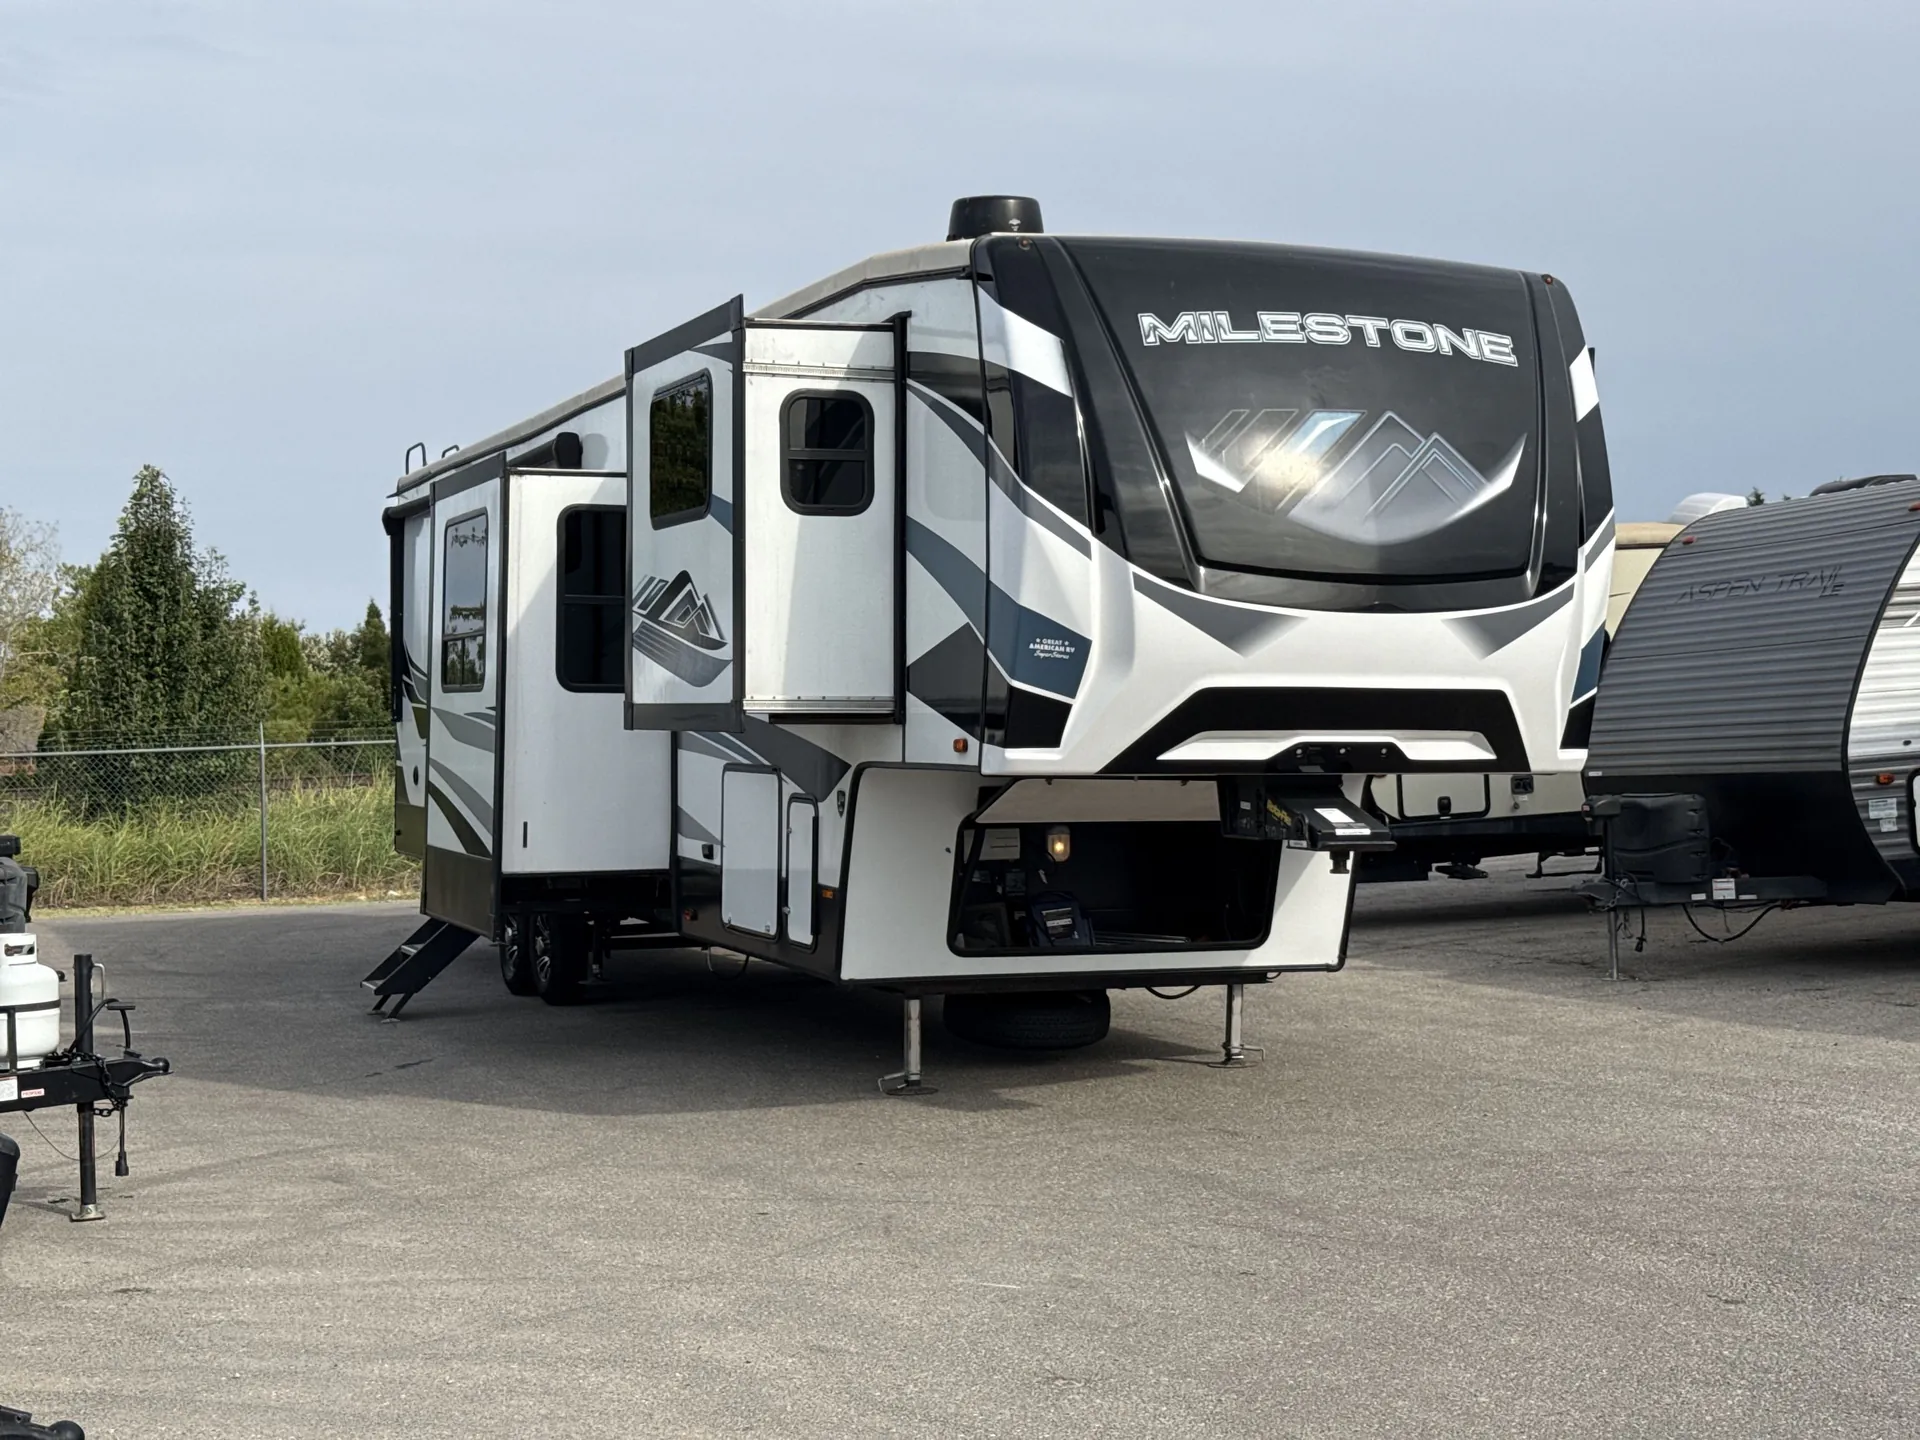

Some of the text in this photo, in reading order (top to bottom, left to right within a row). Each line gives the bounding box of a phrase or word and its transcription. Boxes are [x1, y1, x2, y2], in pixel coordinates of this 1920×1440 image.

[1137, 310, 1519, 367] MILESTONE
[1675, 577, 1765, 603] ASPEN
[1029, 643, 1065, 652] AMERICAN
